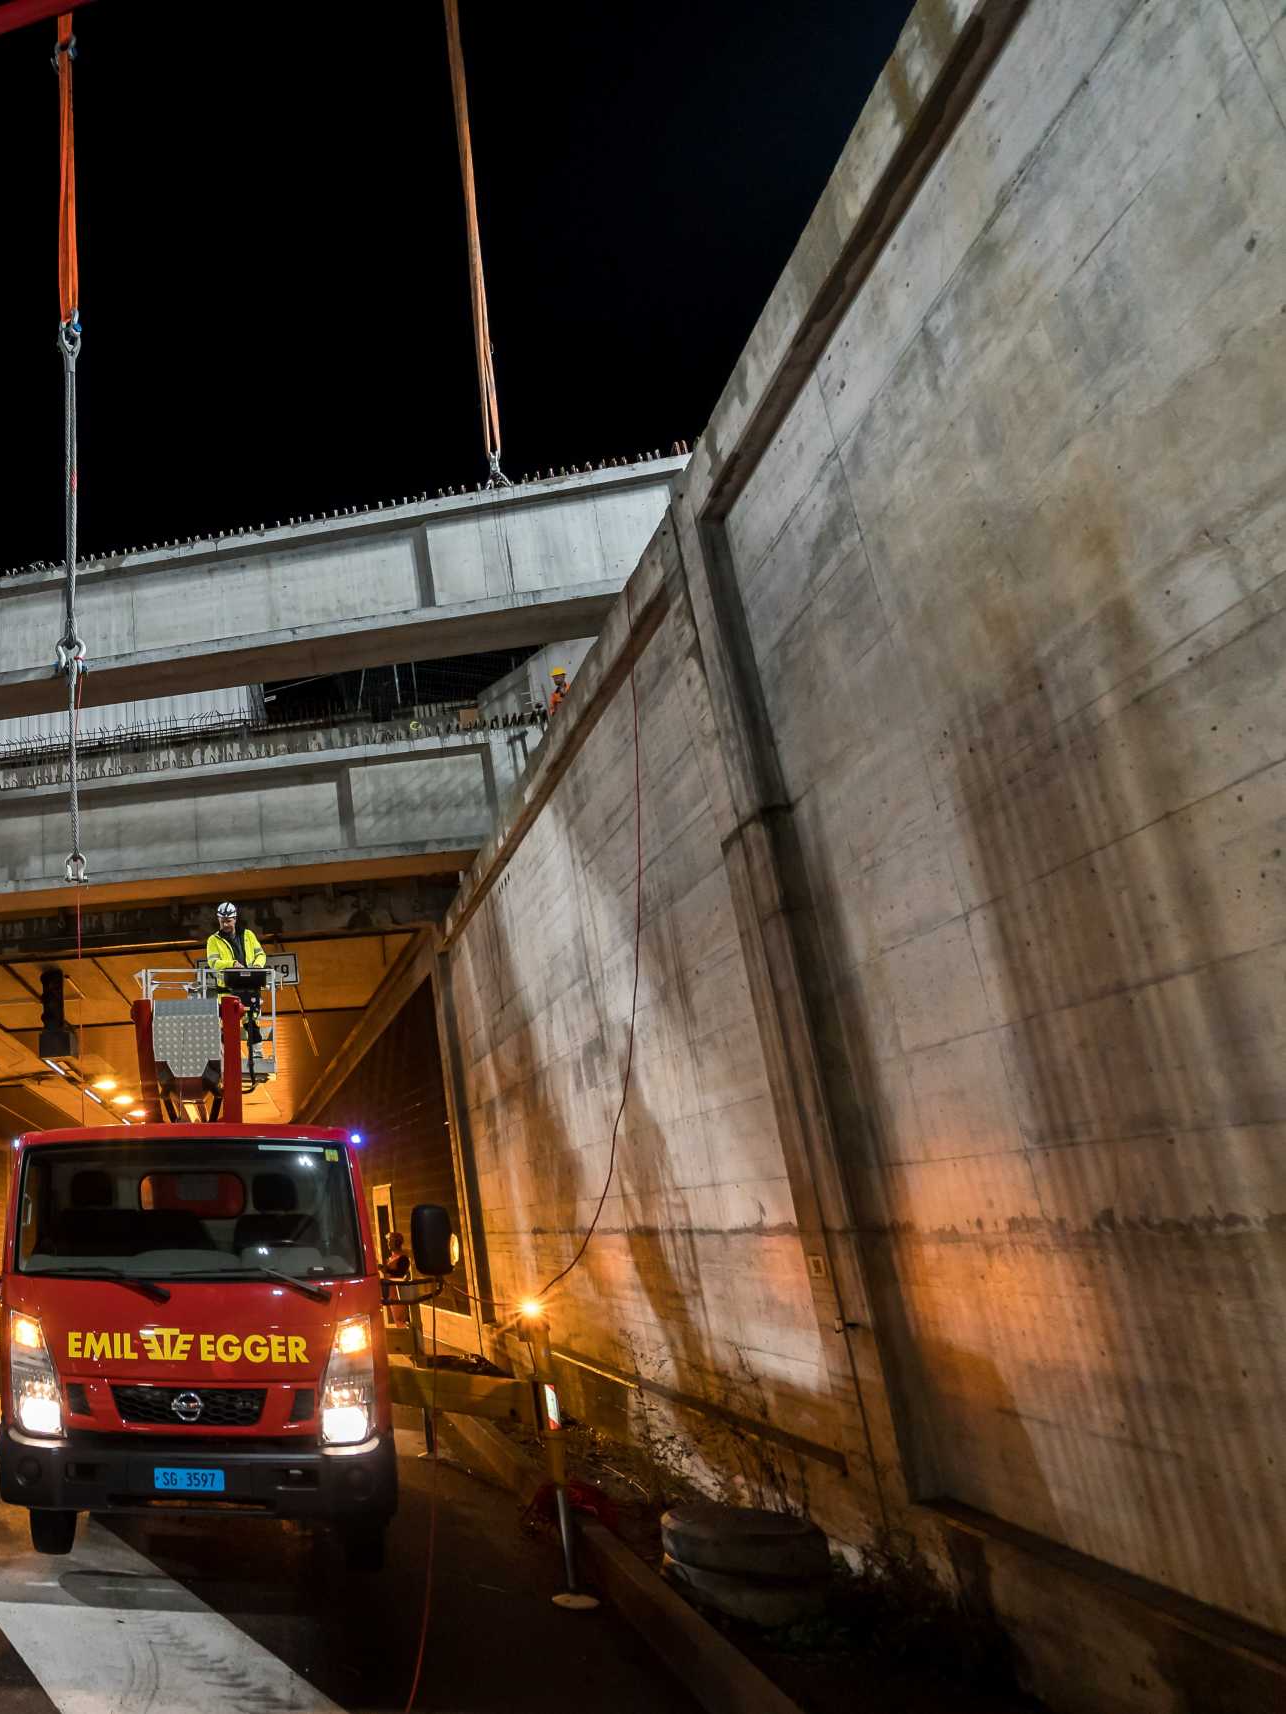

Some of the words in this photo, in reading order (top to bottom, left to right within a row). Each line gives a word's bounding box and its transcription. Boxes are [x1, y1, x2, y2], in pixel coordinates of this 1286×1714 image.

[68, 1332, 138, 1360] EMIL
[200, 1334, 310, 1363] EGGER
[162, 1472, 178, 1486] SG
[186, 1473, 215, 1487] 3597
